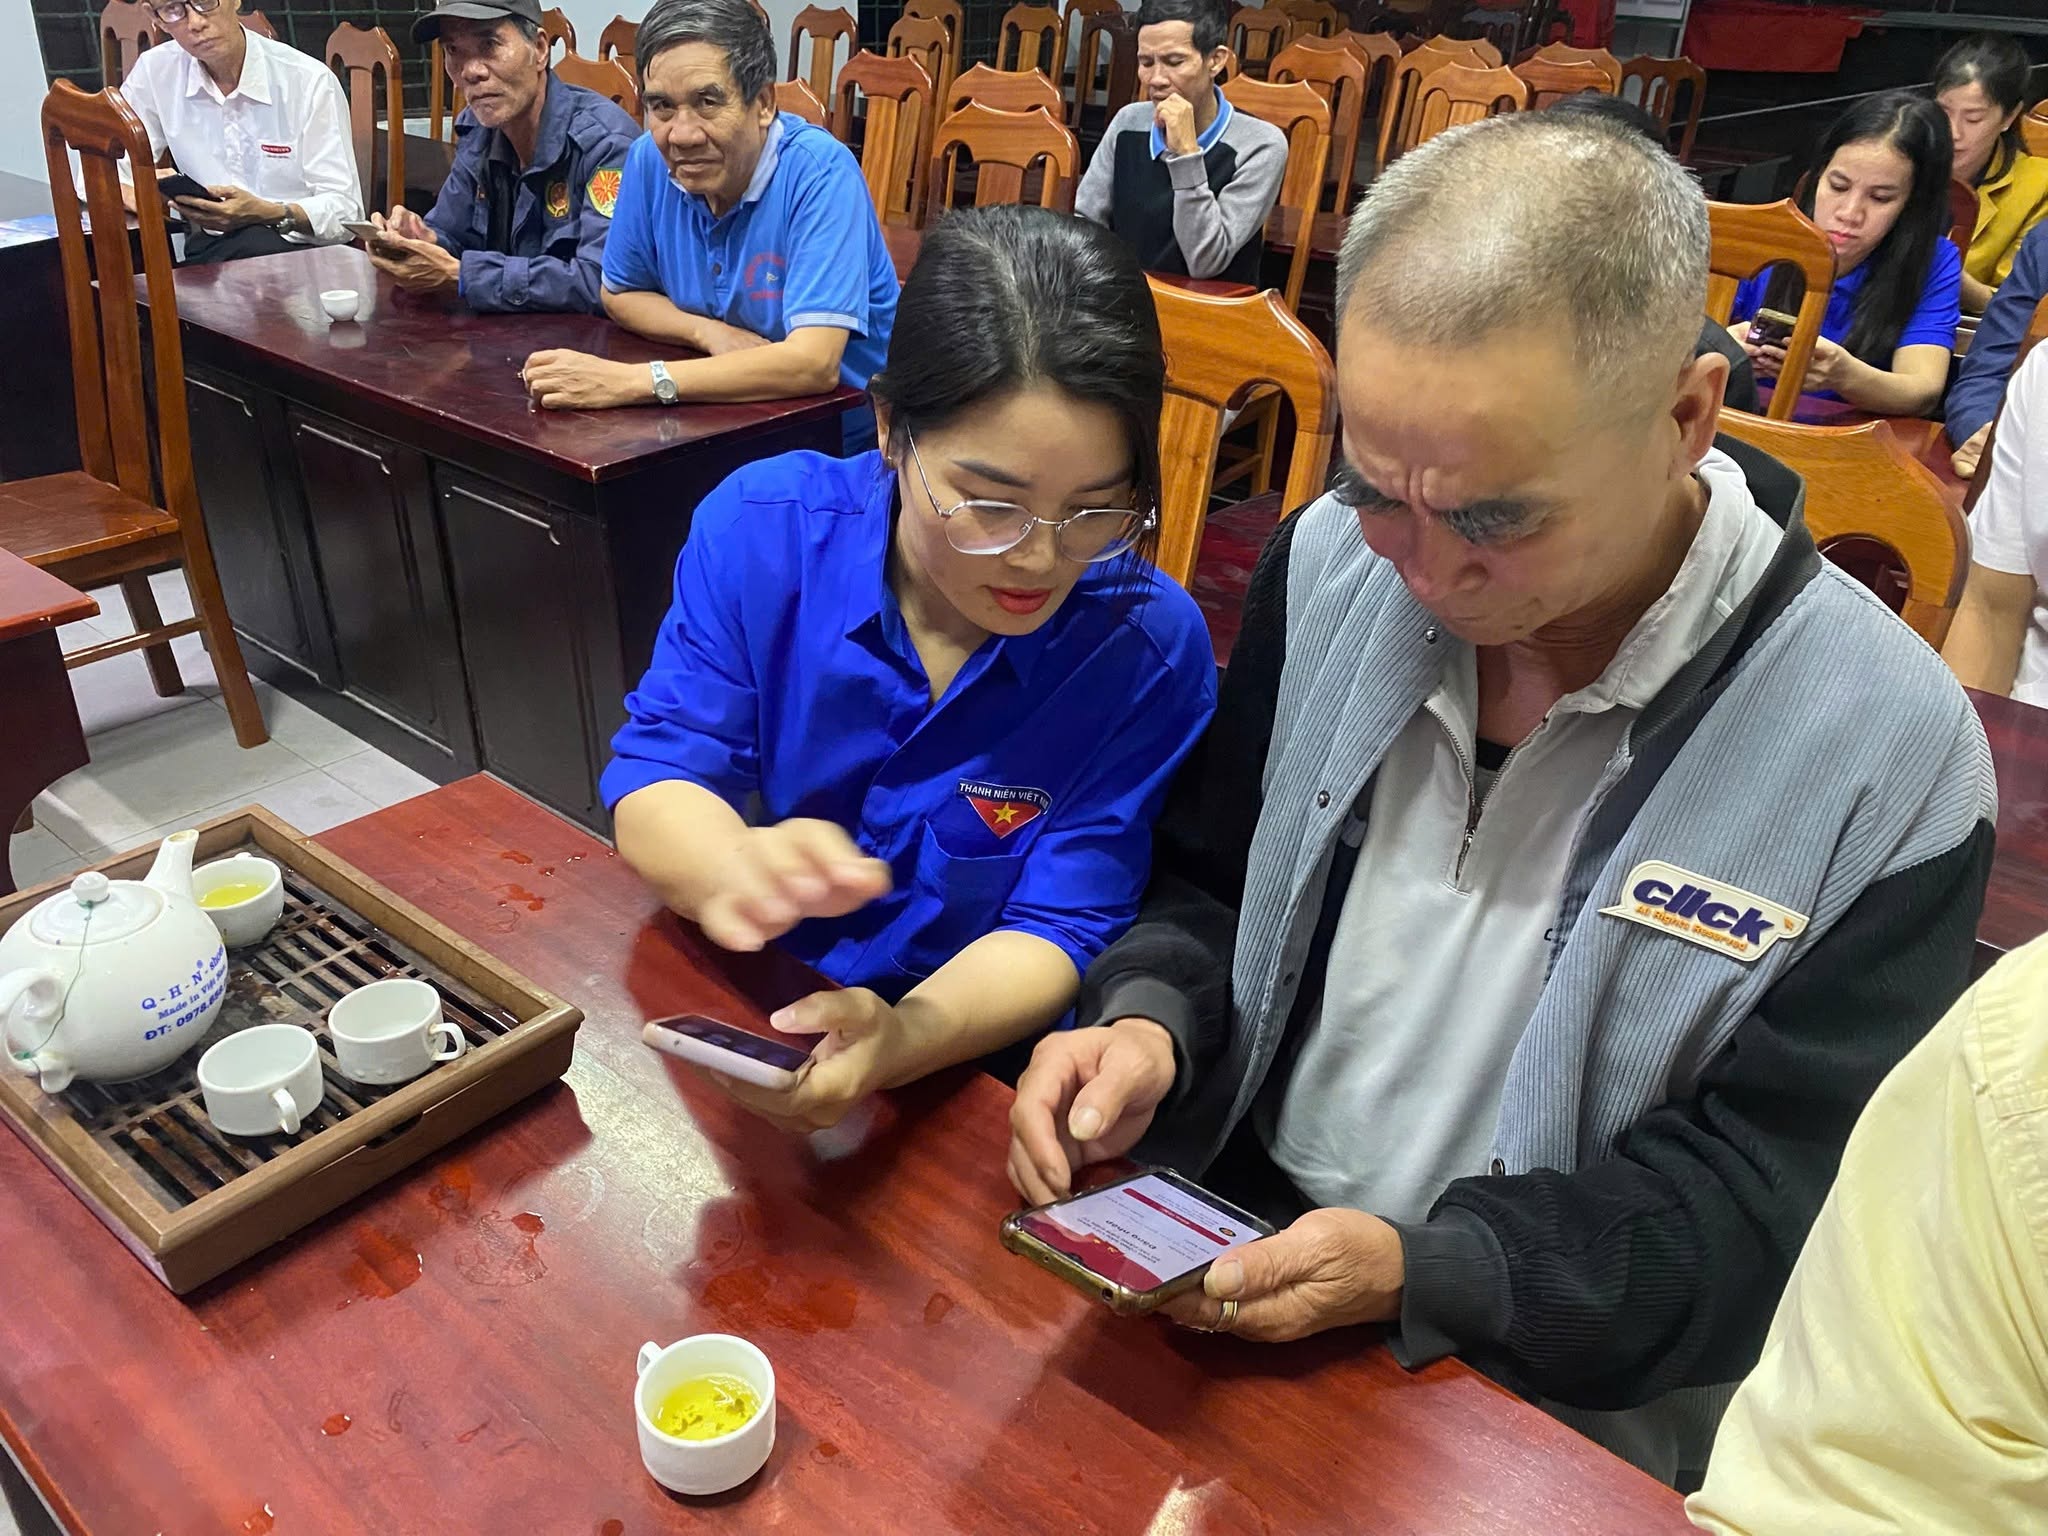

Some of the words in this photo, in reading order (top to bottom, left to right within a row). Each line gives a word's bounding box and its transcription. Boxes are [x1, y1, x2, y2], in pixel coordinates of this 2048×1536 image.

[959, 783, 992, 797] THANH
[1653, 911, 1690, 931] Rights
[1692, 925, 1748, 952] Reserved
[158, 1001, 188, 1020] Made
[190, 994, 200, 1004] in
